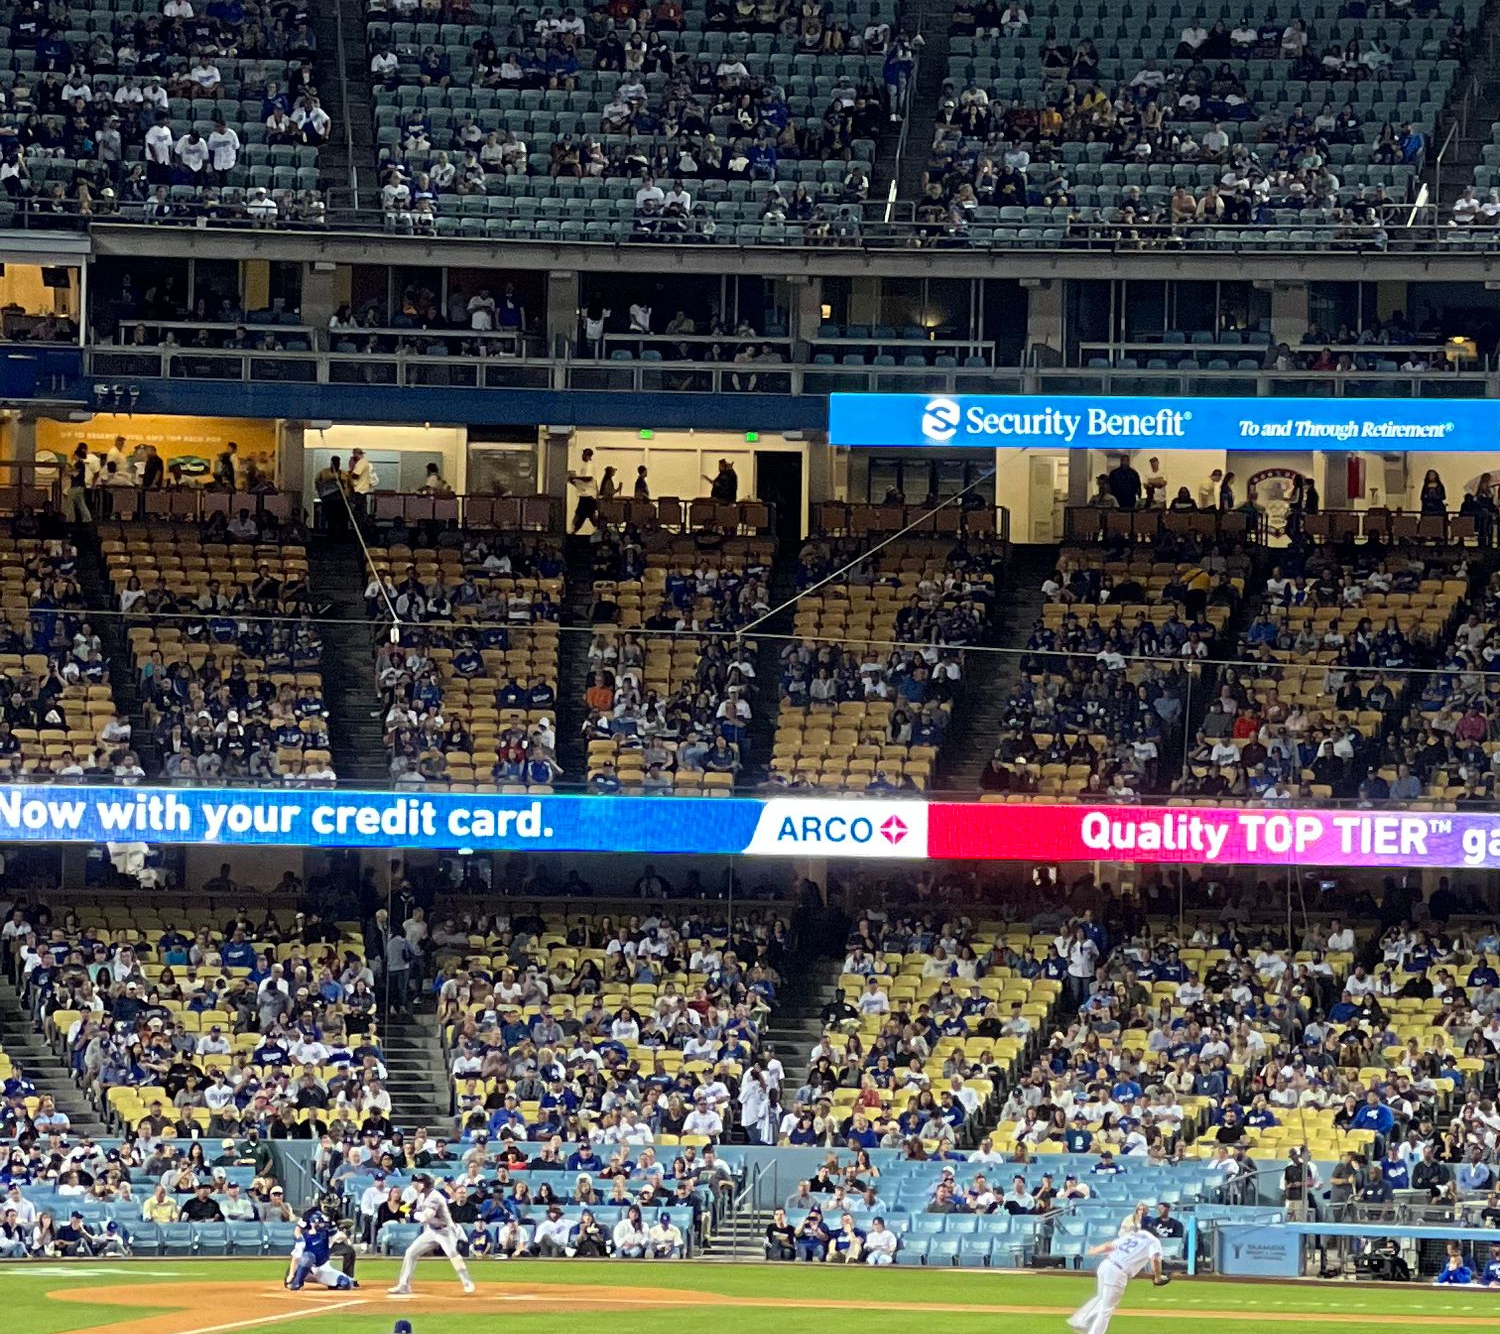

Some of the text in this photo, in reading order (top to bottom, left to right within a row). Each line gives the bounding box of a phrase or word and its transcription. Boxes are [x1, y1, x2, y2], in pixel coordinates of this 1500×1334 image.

[966, 406, 1080, 442] Security
[1239, 421, 1259, 436] To
[1261, 420, 1292, 436] and
[1295, 421, 1358, 441] Through
[0, 791, 553, 841] Now with your credit card.
[777, 816, 873, 844] ARCO
[1082, 811, 1229, 859] Quality
[1239, 815, 1324, 854] TOP
[1118, 1238, 1139, 1254] 22
